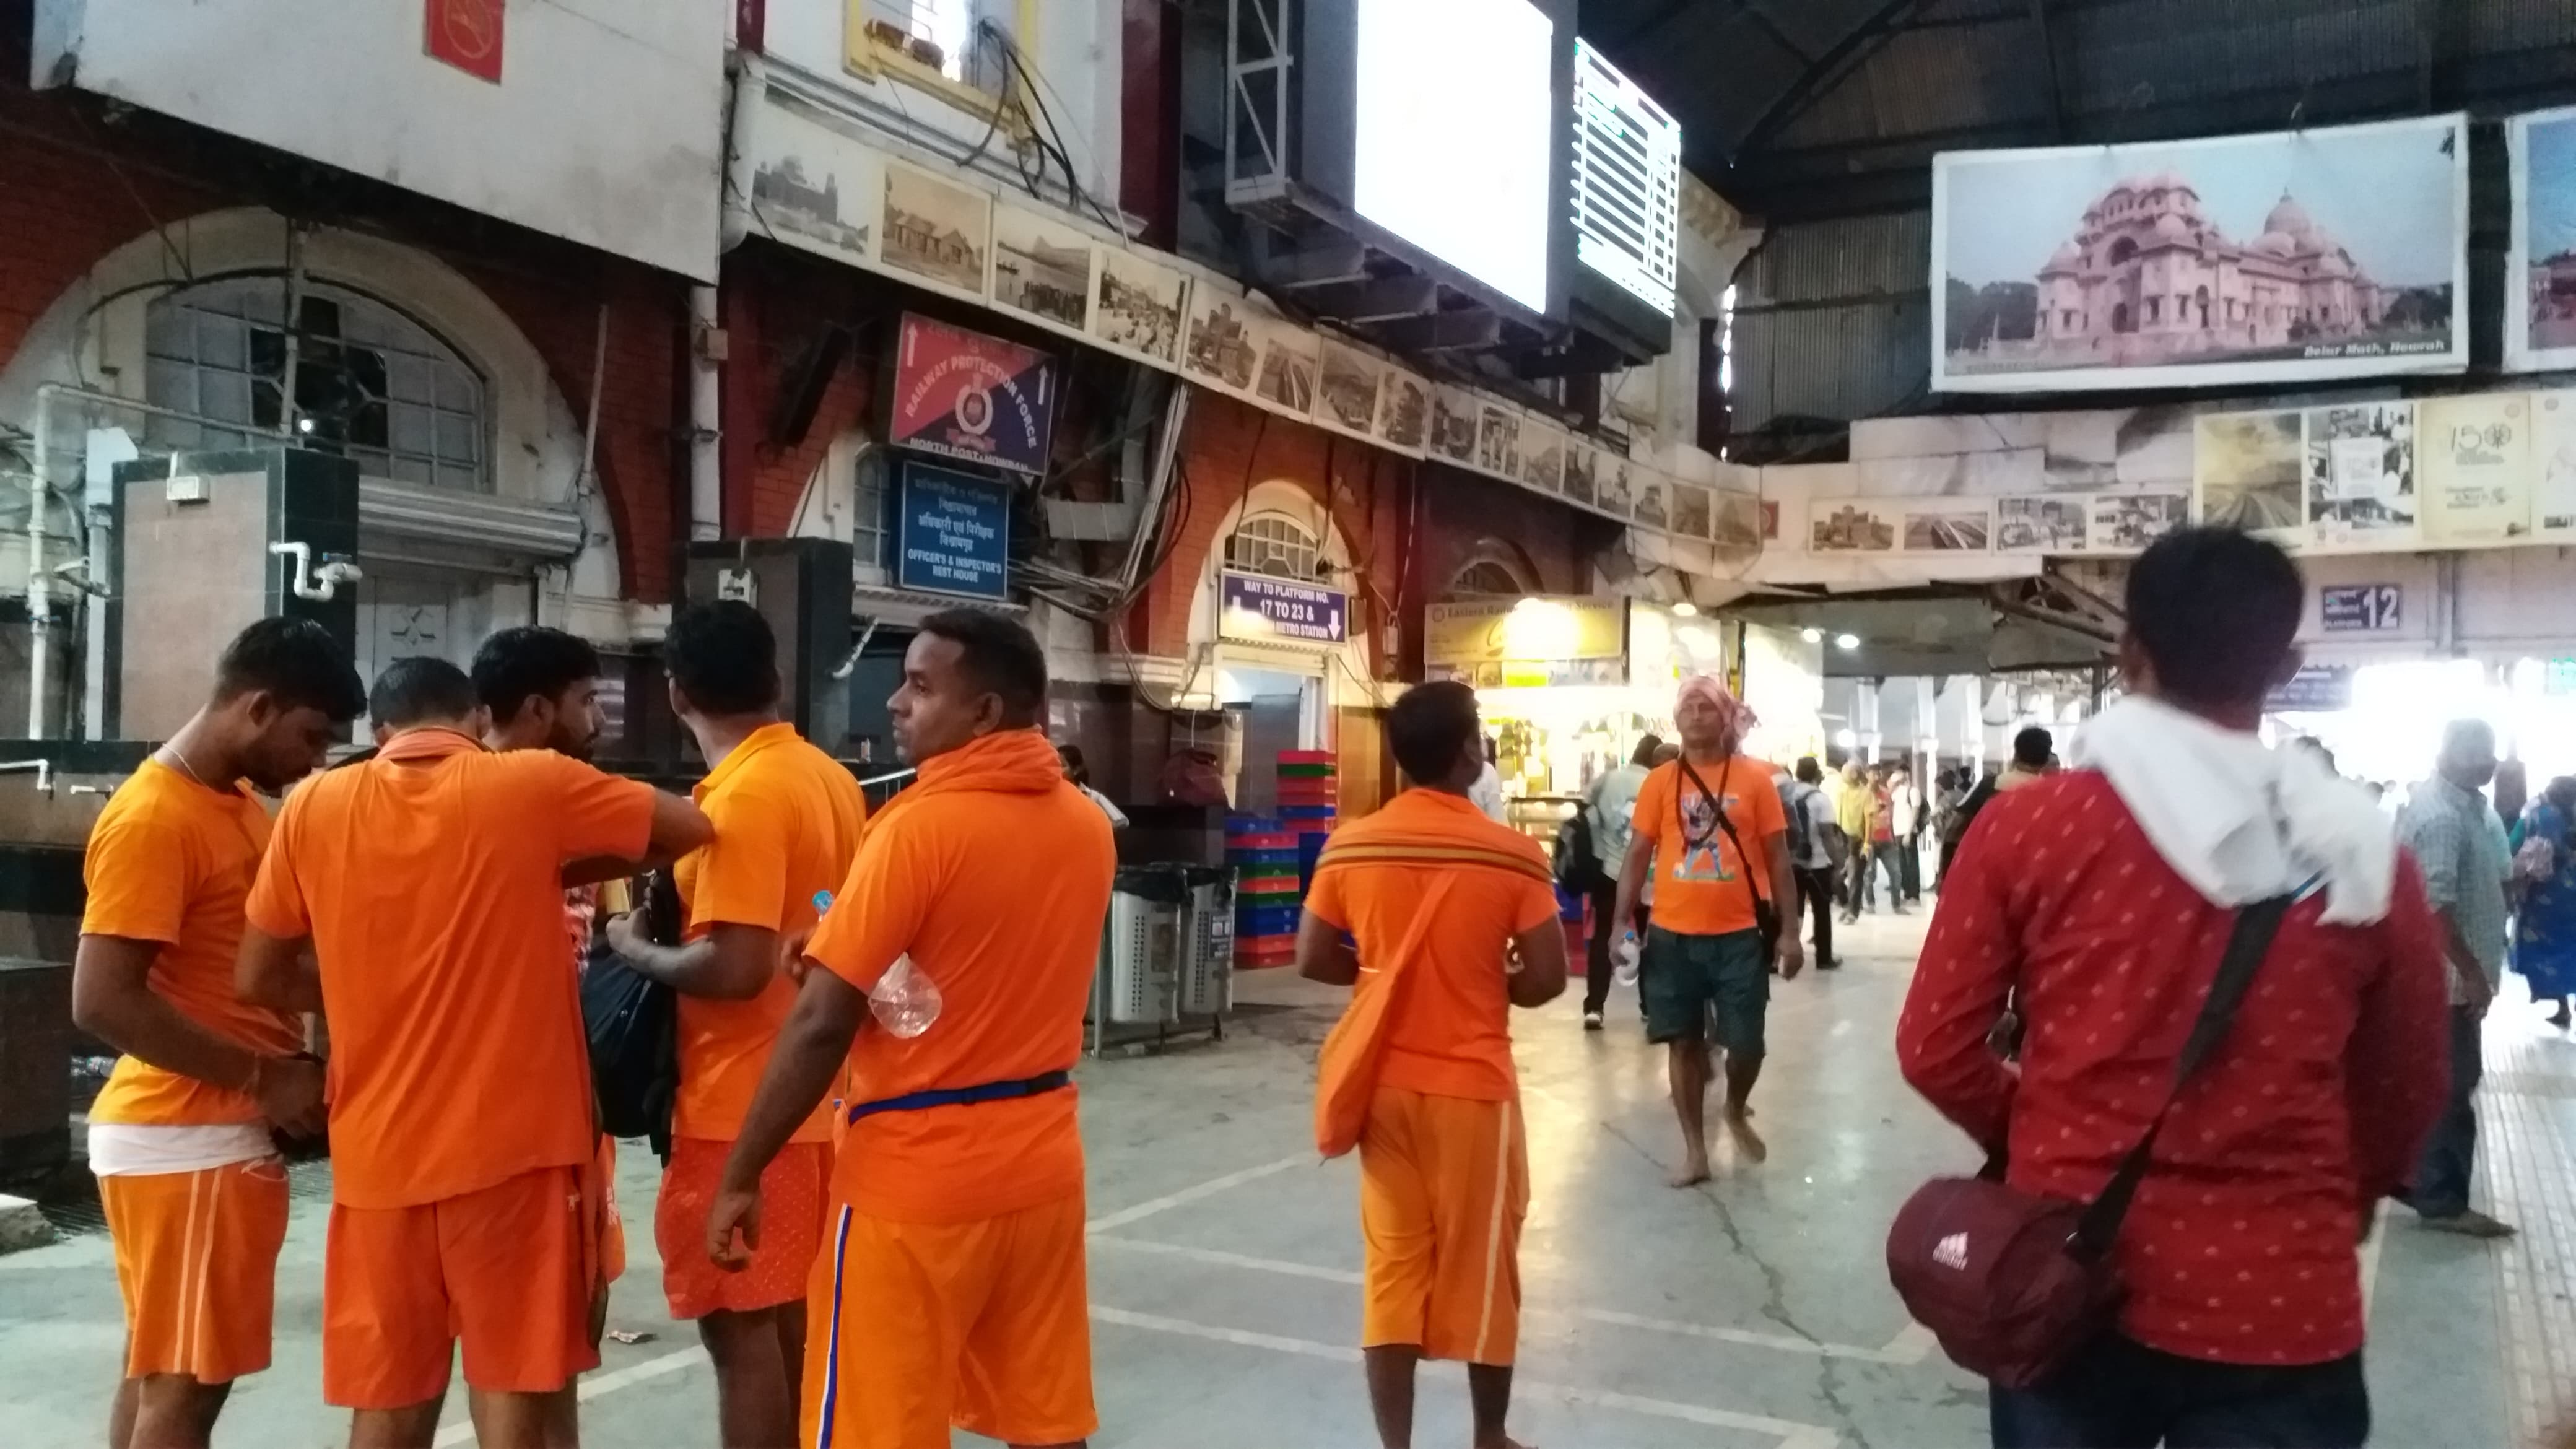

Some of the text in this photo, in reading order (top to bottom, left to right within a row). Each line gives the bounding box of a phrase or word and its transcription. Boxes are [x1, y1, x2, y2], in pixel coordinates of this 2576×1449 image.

[905, 356, 1037, 450] RAILWAY PROTECTION FORCE
[910, 437, 949, 454] NORTH
[908, 548, 947, 566] OFFICER'S
[955, 557, 1002, 575] INSPECTOR'S
[933, 565, 978, 583] REST HOUSE
[1243, 580, 1329, 604] WAY TO PLATFORM NO.
[1260, 599, 1315, 622] 17 TO 23 &
[1448, 606, 1485, 618] Eastern
[2363, 586, 2398, 628] 12
[1300, 624, 1328, 638] STATION
